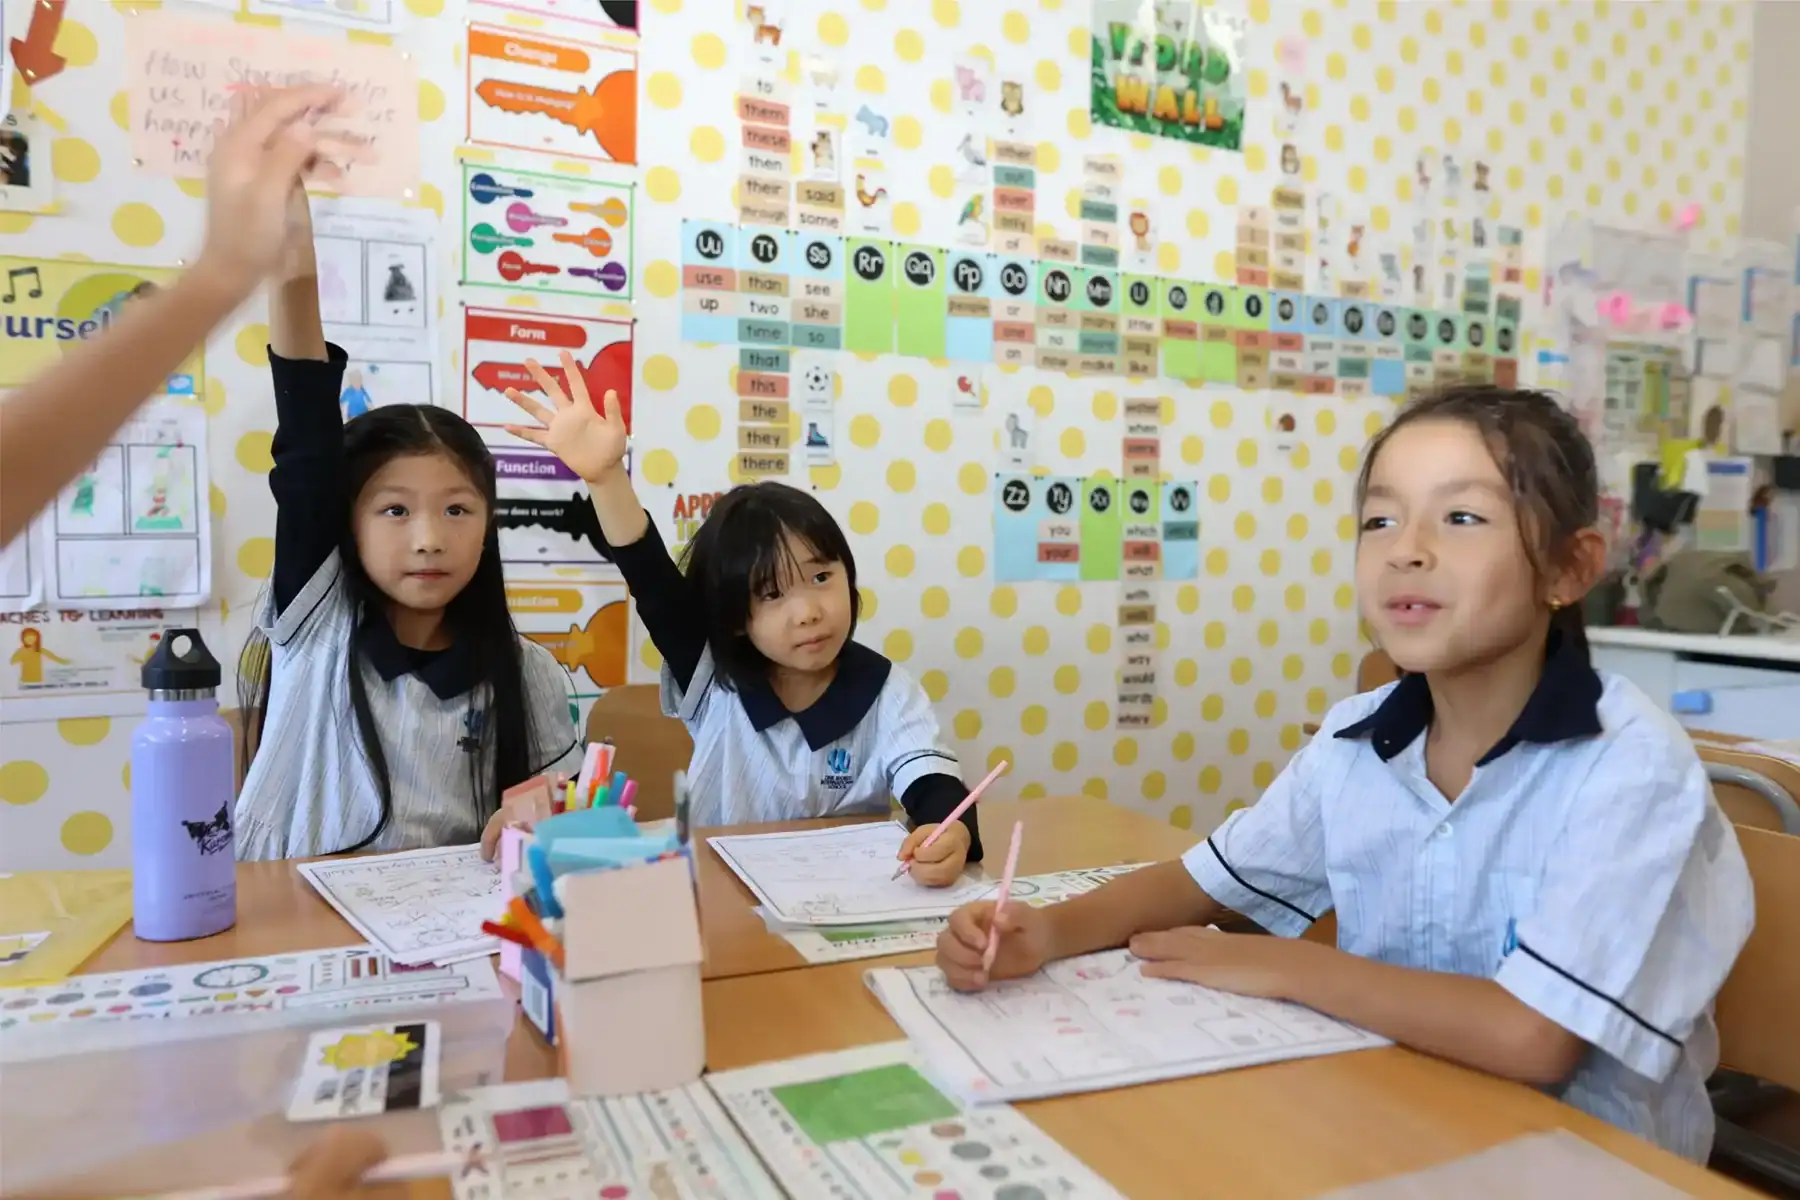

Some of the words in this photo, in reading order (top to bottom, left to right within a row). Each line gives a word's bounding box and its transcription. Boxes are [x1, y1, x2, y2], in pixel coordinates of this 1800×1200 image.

[145, 49, 206, 79] How
[757, 80, 773, 94] to
[1114, 73, 1224, 131] WALL
[744, 103, 785, 121] them
[749, 155, 782, 171] then
[746, 180, 783, 196] their
[805, 188, 835, 204] said
[799, 212, 840, 229] some
[755, 239, 775, 258] Tt
[809, 246, 828, 264] Ss
[858, 252, 883, 273] Rr
[695, 272, 723, 286] use
[748, 275, 782, 291] than
[805, 284, 831, 297] see
[700, 297, 719, 311] up
[750, 301, 779, 316] two
[804, 305, 829, 321] she
[0, 310, 112, 340] ursel
[509, 324, 547, 341] Form
[746, 324, 782, 340] time
[808, 332, 826, 345] so
[1048, 335, 1064, 346] no
[748, 352, 781, 369] that
[750, 378, 777, 394] this
[752, 404, 777, 418] the
[747, 430, 780, 447] they
[496, 460, 556, 475] Function
[742, 454, 785, 471] there
[1005, 486, 1027, 505] Zz
[1049, 524, 1071, 537] you
